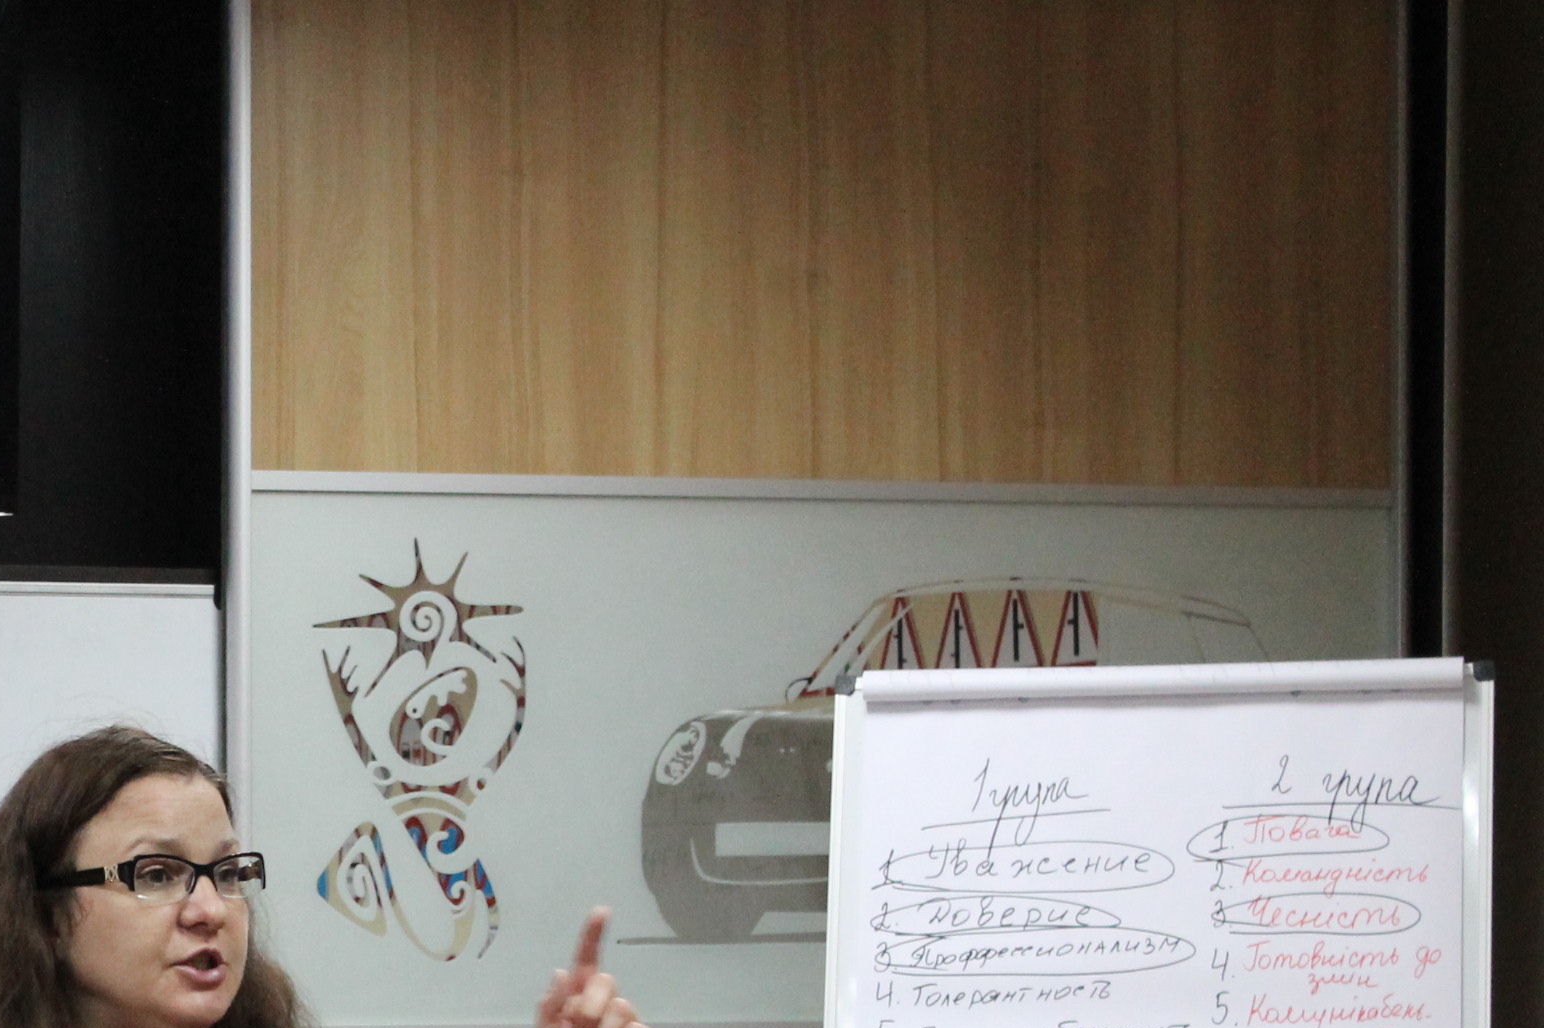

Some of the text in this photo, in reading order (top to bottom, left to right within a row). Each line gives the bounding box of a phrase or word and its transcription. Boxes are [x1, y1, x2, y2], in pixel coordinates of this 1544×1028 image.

[1271, 754, 1441, 834] 2 група
[1242, 814, 1363, 845] Повага
[924, 838, 1152, 880] Уважение
[1209, 857, 1430, 899] 2. Командність
[918, 895, 1090, 932] Доверие
[1246, 894, 1402, 930] Чесність
[1210, 939, 1442, 983] 4. Готовність до
[875, 979, 1112, 1011] 4. Толерантность
[1210, 990, 1239, 1028] 5.
